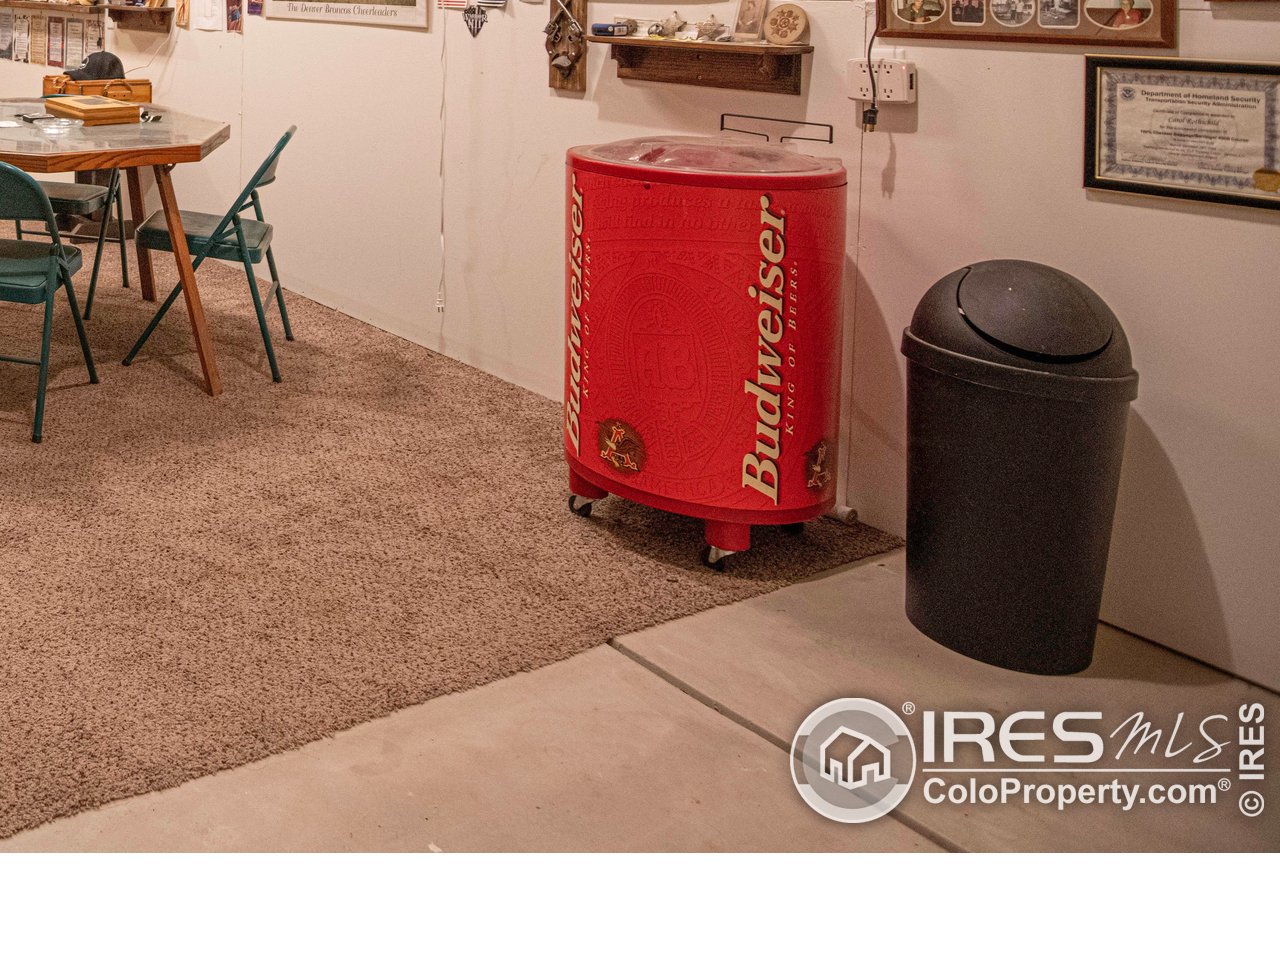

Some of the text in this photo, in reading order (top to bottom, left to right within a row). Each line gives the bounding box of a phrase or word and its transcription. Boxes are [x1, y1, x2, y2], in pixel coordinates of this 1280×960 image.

[287, 2, 398, 17] The Denver Broncos Cheerleaders
[1140, 89, 1182, 99] Department
[1192, 92, 1229, 101] Homeland
[1230, 94, 1261, 104] Security
[741, 192, 787, 506] Budweiser
[788, 343, 797, 368] OF
[784, 381, 796, 437] KING
